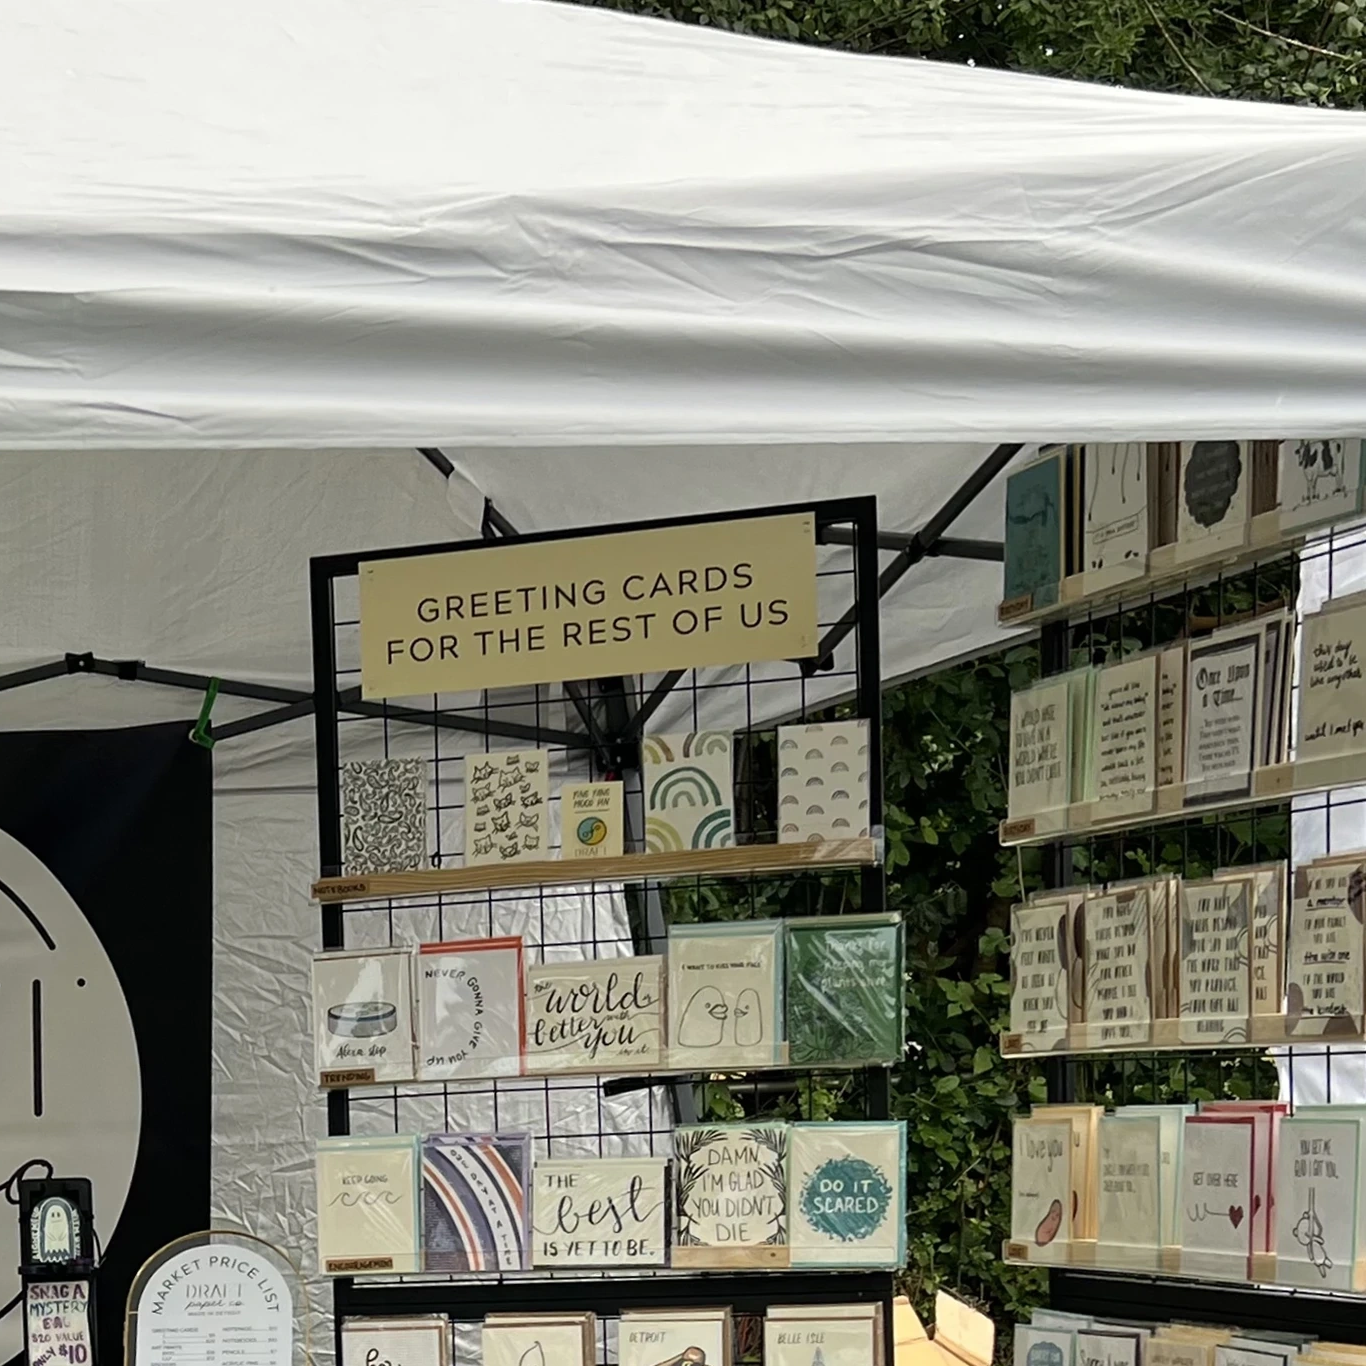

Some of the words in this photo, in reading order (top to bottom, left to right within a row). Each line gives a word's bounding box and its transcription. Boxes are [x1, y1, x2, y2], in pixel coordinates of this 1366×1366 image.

[417, 580, 606, 624] GREETING
[622, 563, 754, 600] CARDS
[386, 635, 460, 665] FOR
[474, 626, 545, 654] THE
[563, 614, 657, 647] REST
[672, 607, 724, 636] OF
[739, 600, 789, 628] US
[1335, 640, 1352, 659] day
[1196, 667, 1221, 690] Once
[1227, 664, 1250, 683] Upon
[425, 968, 466, 981] NEVER
[467, 976, 484, 1016] GONNA
[546, 972, 644, 1013] world
[535, 1016, 604, 1046] better
[583, 1024, 634, 1059] you
[1026, 1132, 1045, 1159] love
[1048, 1139, 1063, 1172] you
[364, 1174, 388, 1184] GOING
[544, 1174, 578, 1188] THE
[700, 1171, 724, 1192] I'M
[728, 1170, 765, 1191] GLAD
[820, 1179, 844, 1193] DO
[853, 1179, 873, 1193] IT
[1193, 1172, 1205, 1186] GET
[554, 1175, 655, 1234] best
[691, 1198, 721, 1218] YOU
[725, 1194, 776, 1218] DIDN'T
[813, 1197, 880, 1215] SCARED
[715, 1222, 750, 1242] DIE
[543, 1241, 557, 1256] IS
[565, 1241, 597, 1256] YET
[600, 1241, 623, 1256] TO
[30, 1284, 70, 1300] SNAG
[73, 1283, 86, 1299] A
[151, 1258, 201, 1315] MARKET
[209, 1255, 260, 1280] PRICE
[257, 1278, 280, 1312] LIST
[30, 1299, 88, 1316] MYSTERY
[184, 1299, 225, 1311] paper
[32, 1334, 52, 1343] $20
[55, 1332, 84, 1342] VALUE
[629, 1332, 665, 1343] DETROIT
[777, 1332, 802, 1344] BELLE
[805, 1332, 825, 1344] ISLE
[59, 1343, 87, 1365] $10
